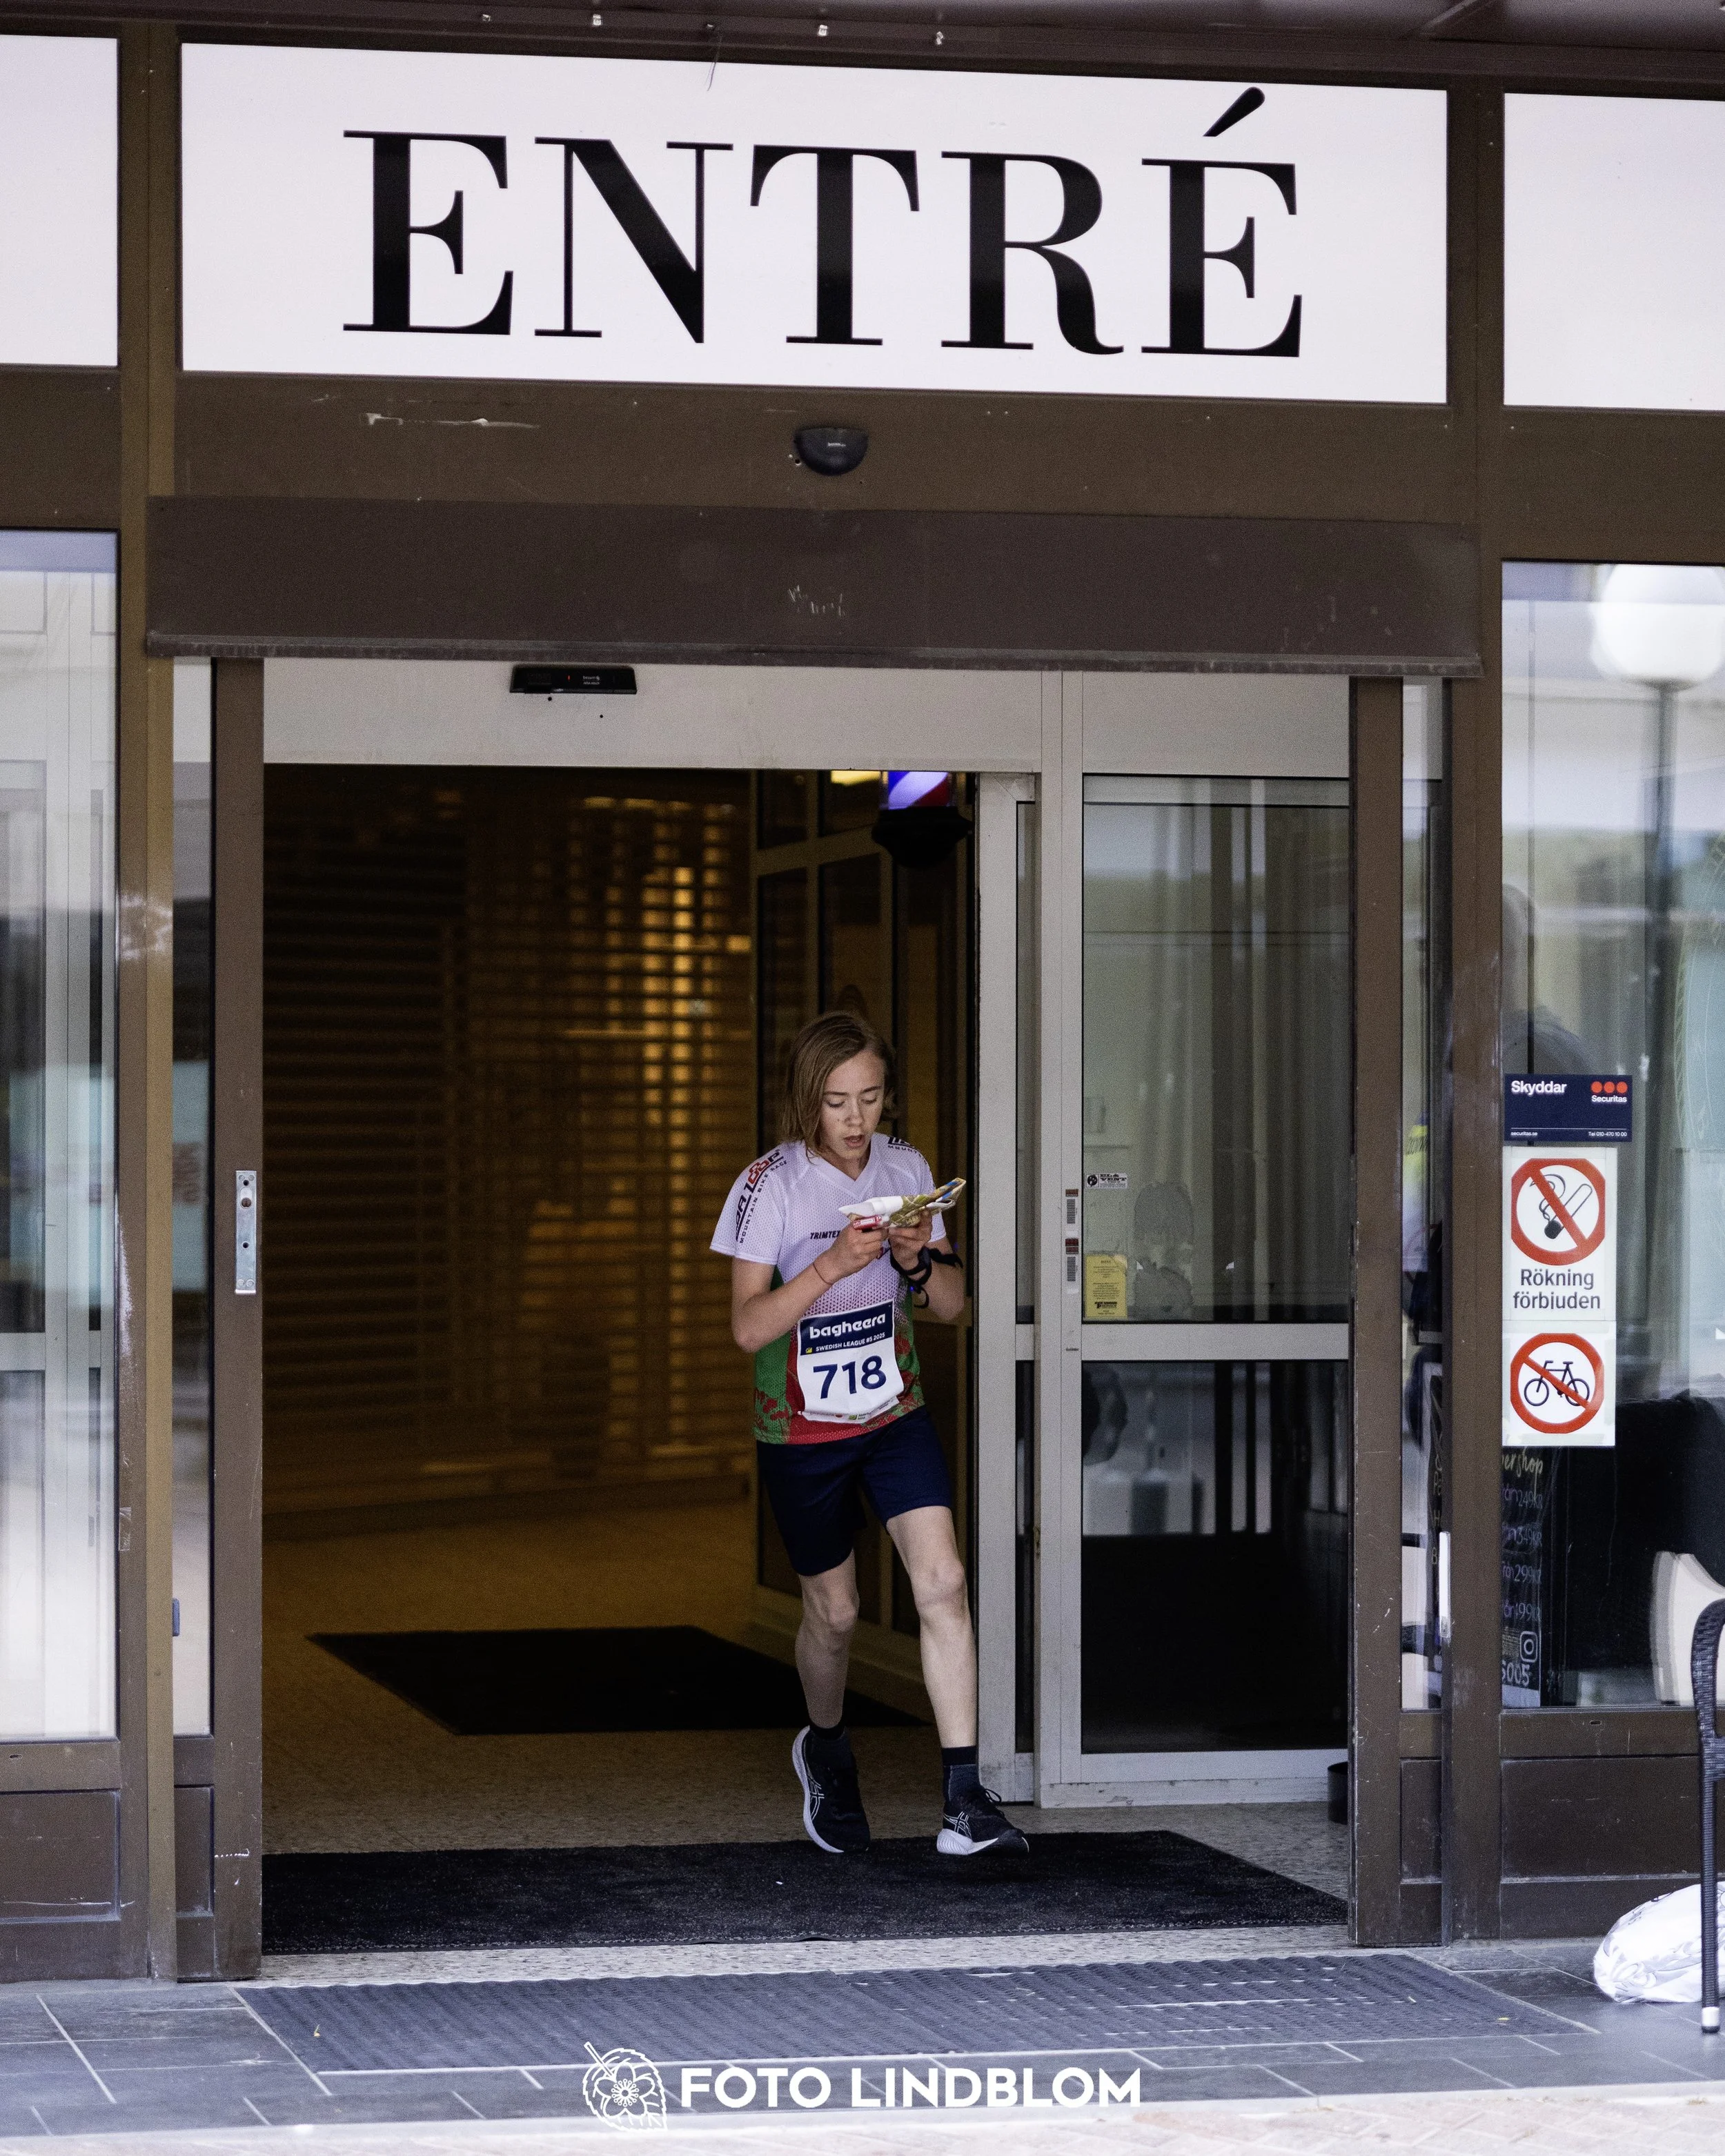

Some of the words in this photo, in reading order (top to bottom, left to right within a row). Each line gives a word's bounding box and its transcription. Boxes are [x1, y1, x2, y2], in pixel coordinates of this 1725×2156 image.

[344, 88, 1303, 358] ENTRÉ
[1511, 1080, 1567, 1096] Skyddar
[1591, 1095, 1627, 1103] Securitas
[740, 1197, 758, 1244] MOUNTAIN
[758, 1173, 769, 1194] BIKE
[1521, 1268, 1594, 1290] Rökning
[809, 1314, 886, 1339] bagheera
[816, 1343, 842, 1352] SWEDISH
[843, 1338, 865, 1347] LEAGUE
[874, 1332, 885, 1341] 2025
[814, 1356, 886, 1399] 718
[1501, 1446, 1544, 1503] ershop
